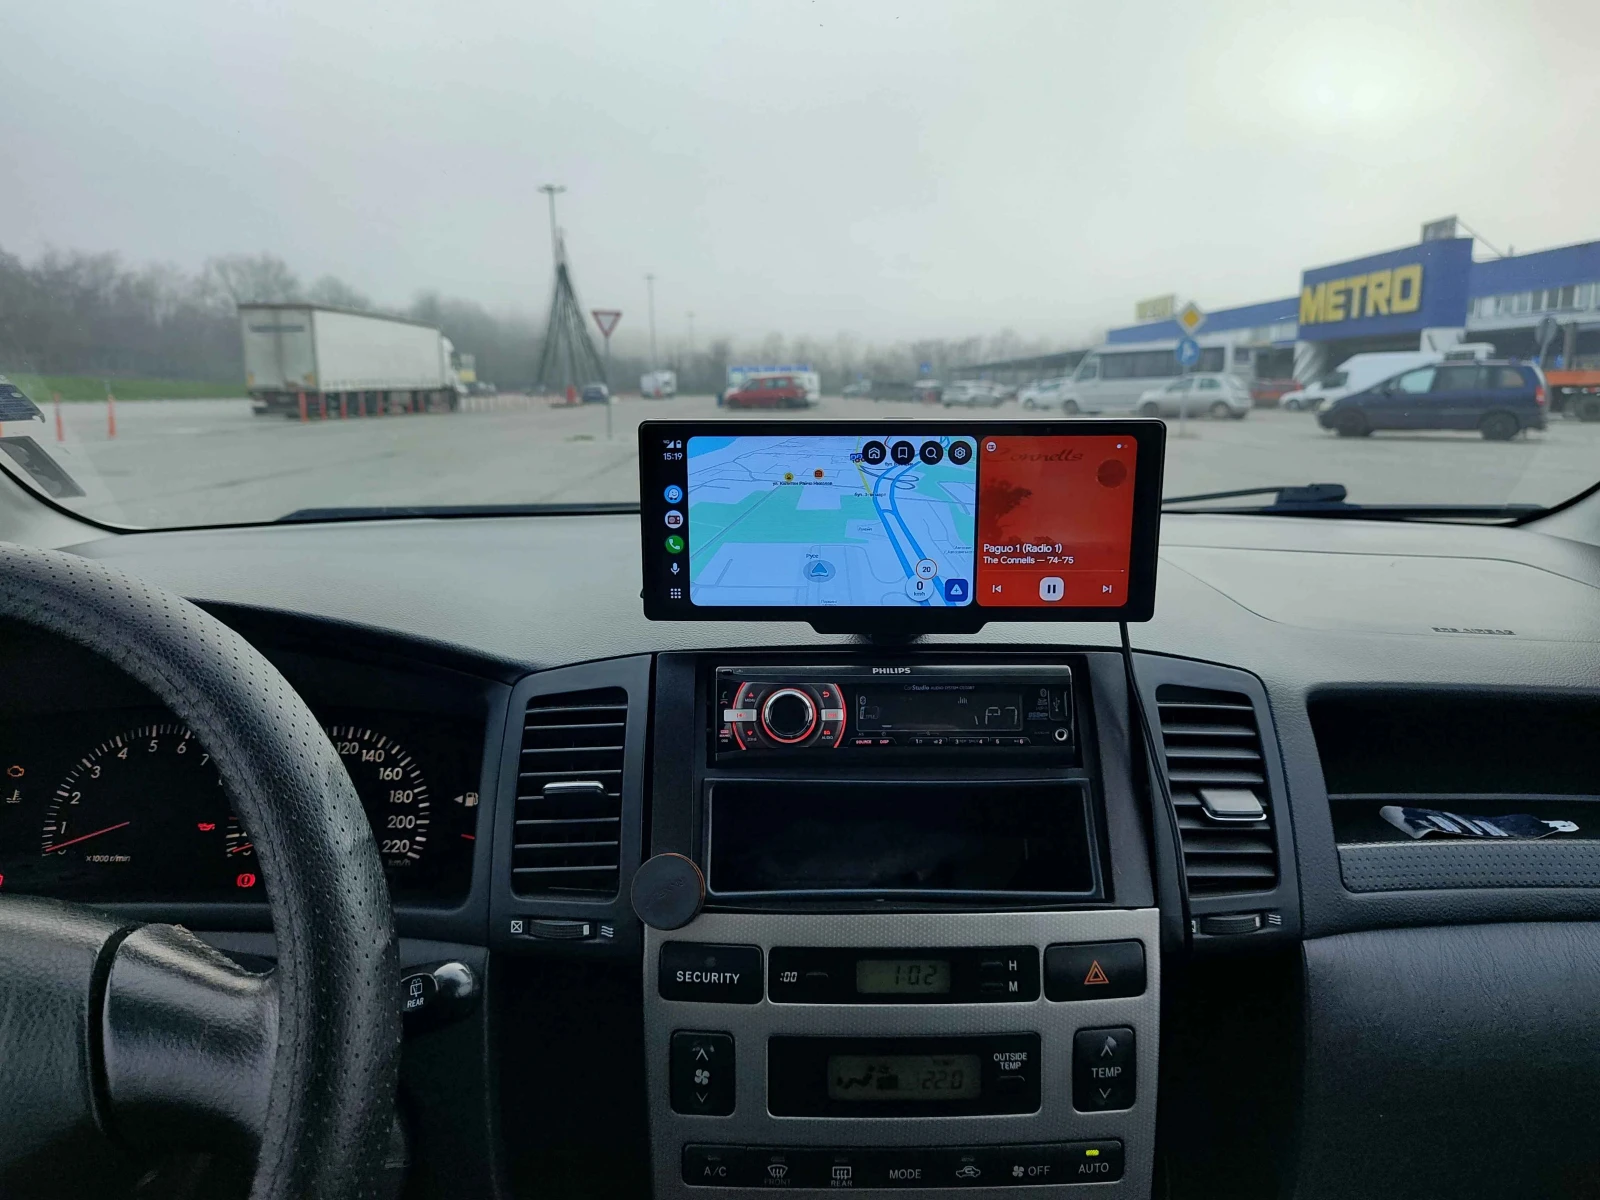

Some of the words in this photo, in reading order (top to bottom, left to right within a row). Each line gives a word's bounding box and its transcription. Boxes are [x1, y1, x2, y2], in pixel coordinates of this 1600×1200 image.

[1302, 264, 1424, 325] METRO
[663, 452, 683, 460] 15:19
[1015, 544, 1020, 553] 1
[1022, 543, 1052, 554] (Radio
[1054, 543, 1063, 554] 1)
[983, 556, 998, 564] The
[1000, 556, 1035, 564] Connells
[916, 581, 924, 591] 0
[872, 667, 911, 675] PHILIPS
[148, 740, 158, 753] 5
[177, 742, 187, 754] 6
[336, 741, 360, 755] 120
[117, 747, 128, 760] 4
[200, 753, 210, 766] 7
[361, 750, 385, 763] 140
[90, 765, 101, 779] 3
[378, 768, 403, 781] 160
[70, 791, 81, 805] 2
[389, 790, 413, 804] 180
[60, 821, 67, 834] 1
[387, 815, 416, 829] 200
[381, 839, 410, 853] 220
[1008, 960, 1018, 971] H
[675, 970, 741, 985] SECURITY
[779, 971, 798, 983] :00
[1008, 981, 1018, 993] M
[406, 998, 425, 1009] REAR
[993, 1053, 1028, 1062] OUTSIDE
[999, 1061, 1022, 1071] TEMP
[1090, 1066, 1123, 1079] TEMP
[703, 1165, 728, 1178] A/C
[888, 1168, 922, 1180] MODE
[1027, 1165, 1051, 1176] OFF
[1078, 1162, 1110, 1175] AUTO
[763, 1177, 792, 1187] FRONT
[830, 1180, 853, 1188] REAR
